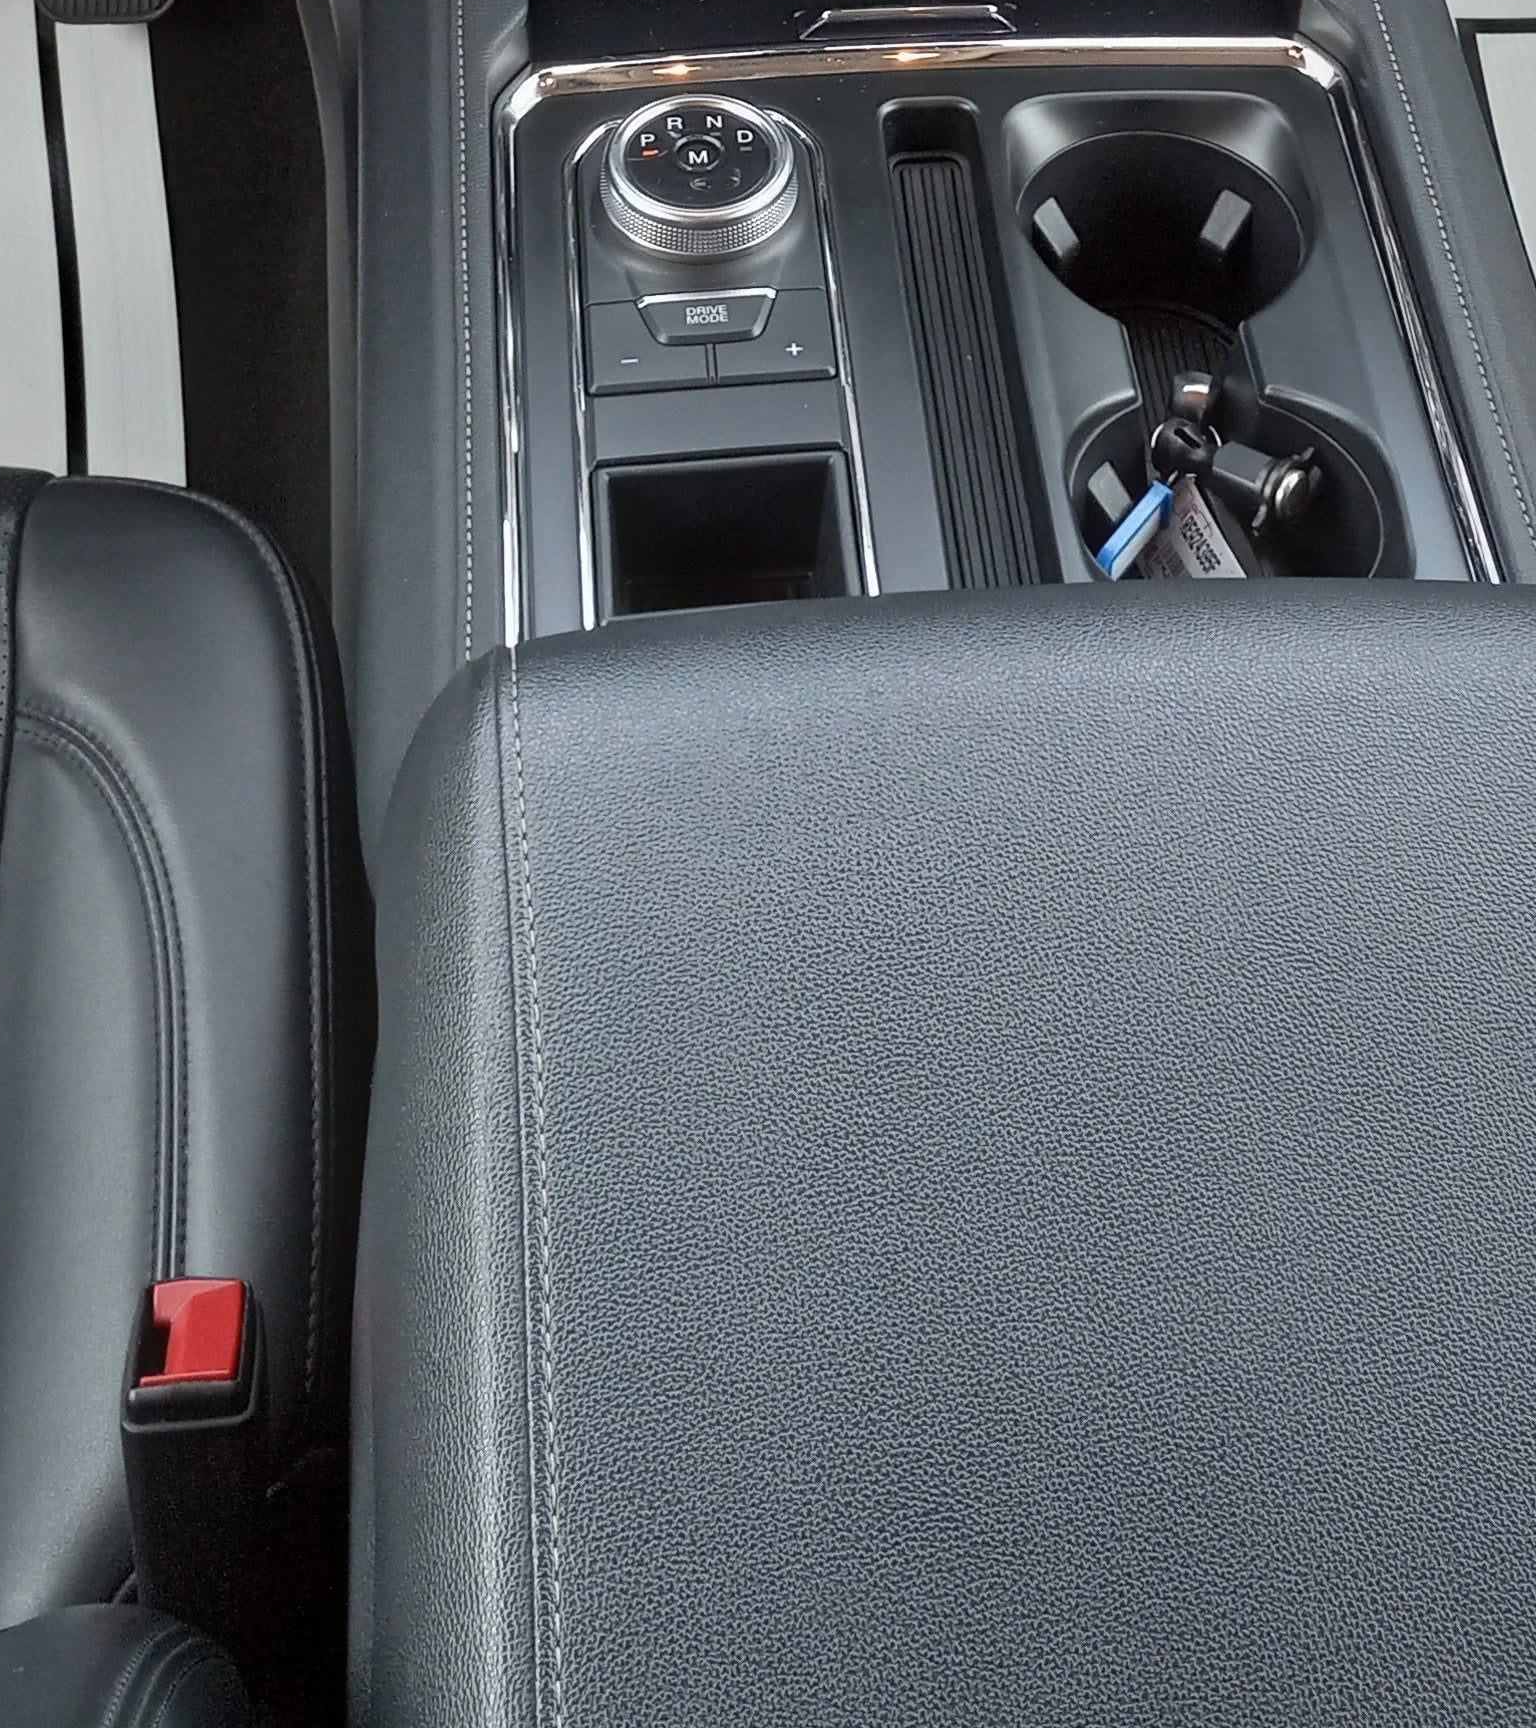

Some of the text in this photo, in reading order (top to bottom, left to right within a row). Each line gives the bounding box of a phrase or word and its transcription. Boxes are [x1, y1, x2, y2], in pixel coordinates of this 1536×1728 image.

[666, 116, 683, 130] R
[705, 114, 723, 128] N
[639, 133, 656, 147] P
[736, 130, 754, 143] D
[688, 150, 709, 165] M
[686, 304, 727, 316] DRIVE
[686, 313, 729, 325] MODE
